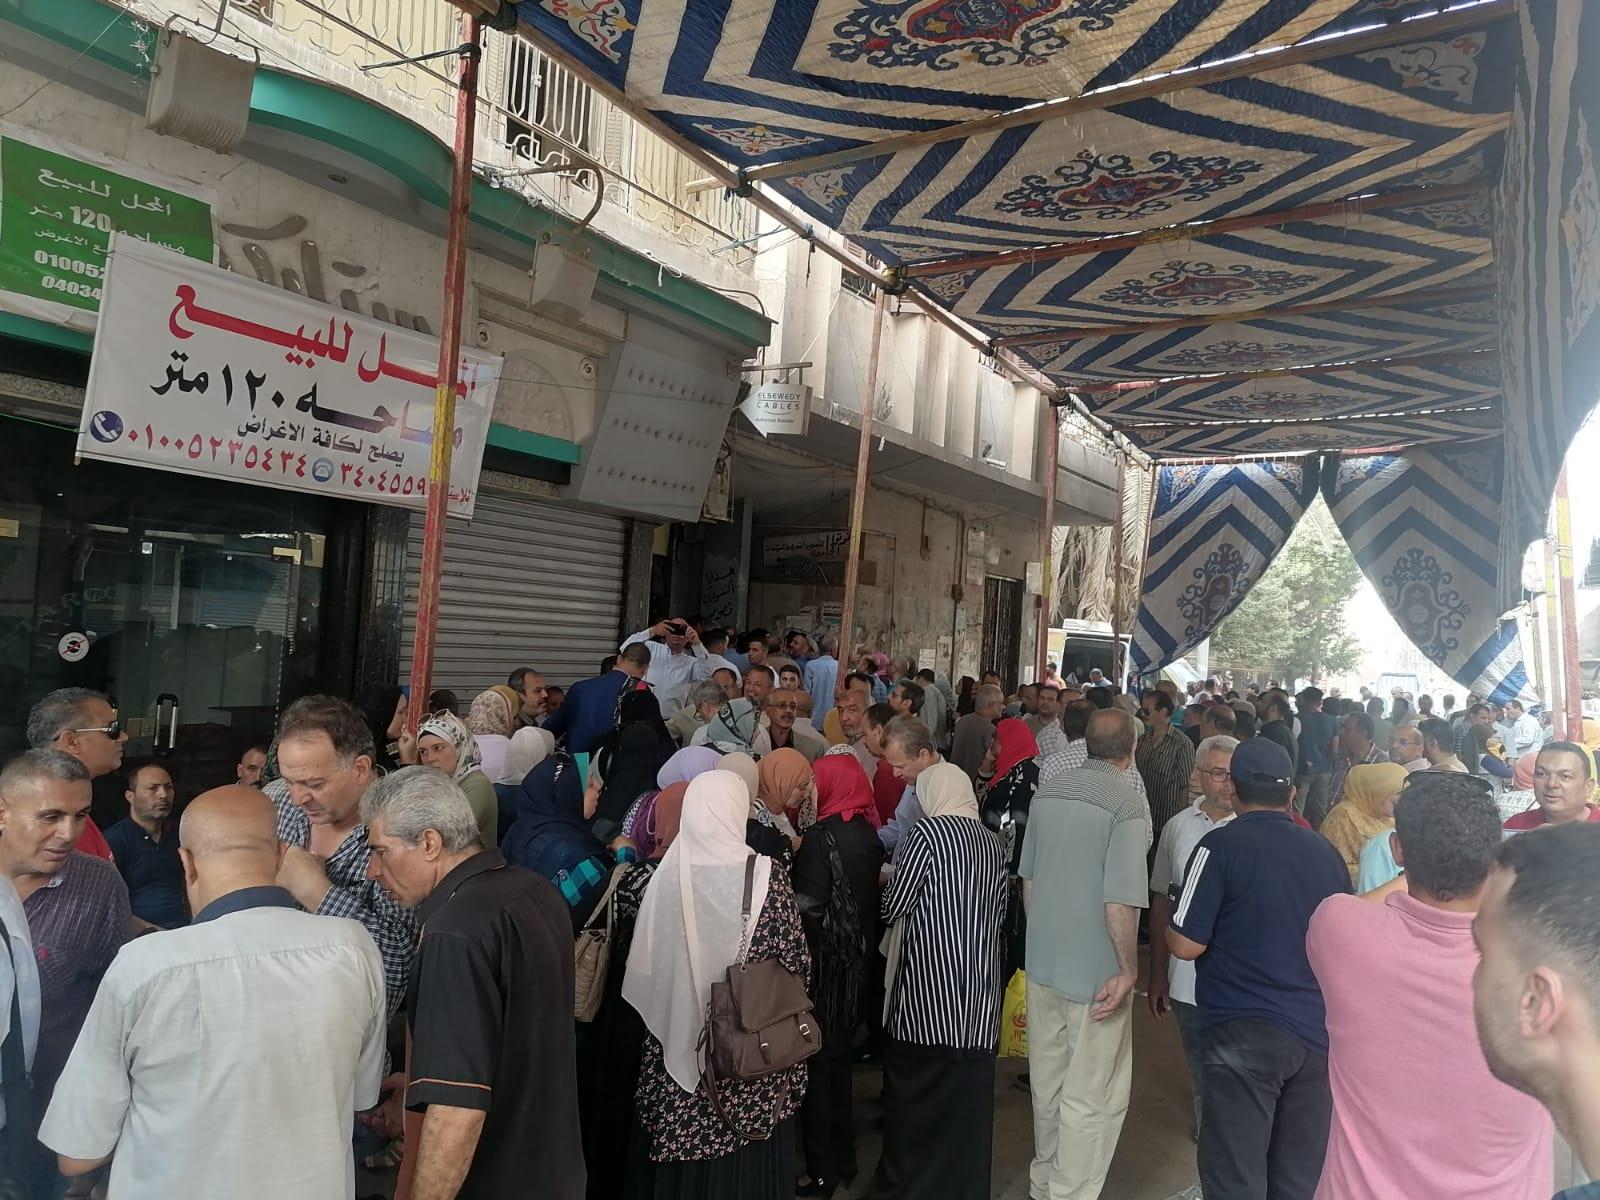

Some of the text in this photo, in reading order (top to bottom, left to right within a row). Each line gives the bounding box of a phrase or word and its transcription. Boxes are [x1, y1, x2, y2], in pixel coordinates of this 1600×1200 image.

[38, 168, 112, 198] للبيع
[29, 205, 64, 220] متر
[69, 205, 112, 233] 120
[168, 284, 354, 369] للبيع
[150, 350, 209, 396] متر
[221, 363, 285, 412] ١٢٠
[757, 392, 801, 400] ELSEWEDY
[756, 401, 801, 410] CABLES
[311, 427, 364, 453] لكافة
[367, 443, 405, 467] يصلح
